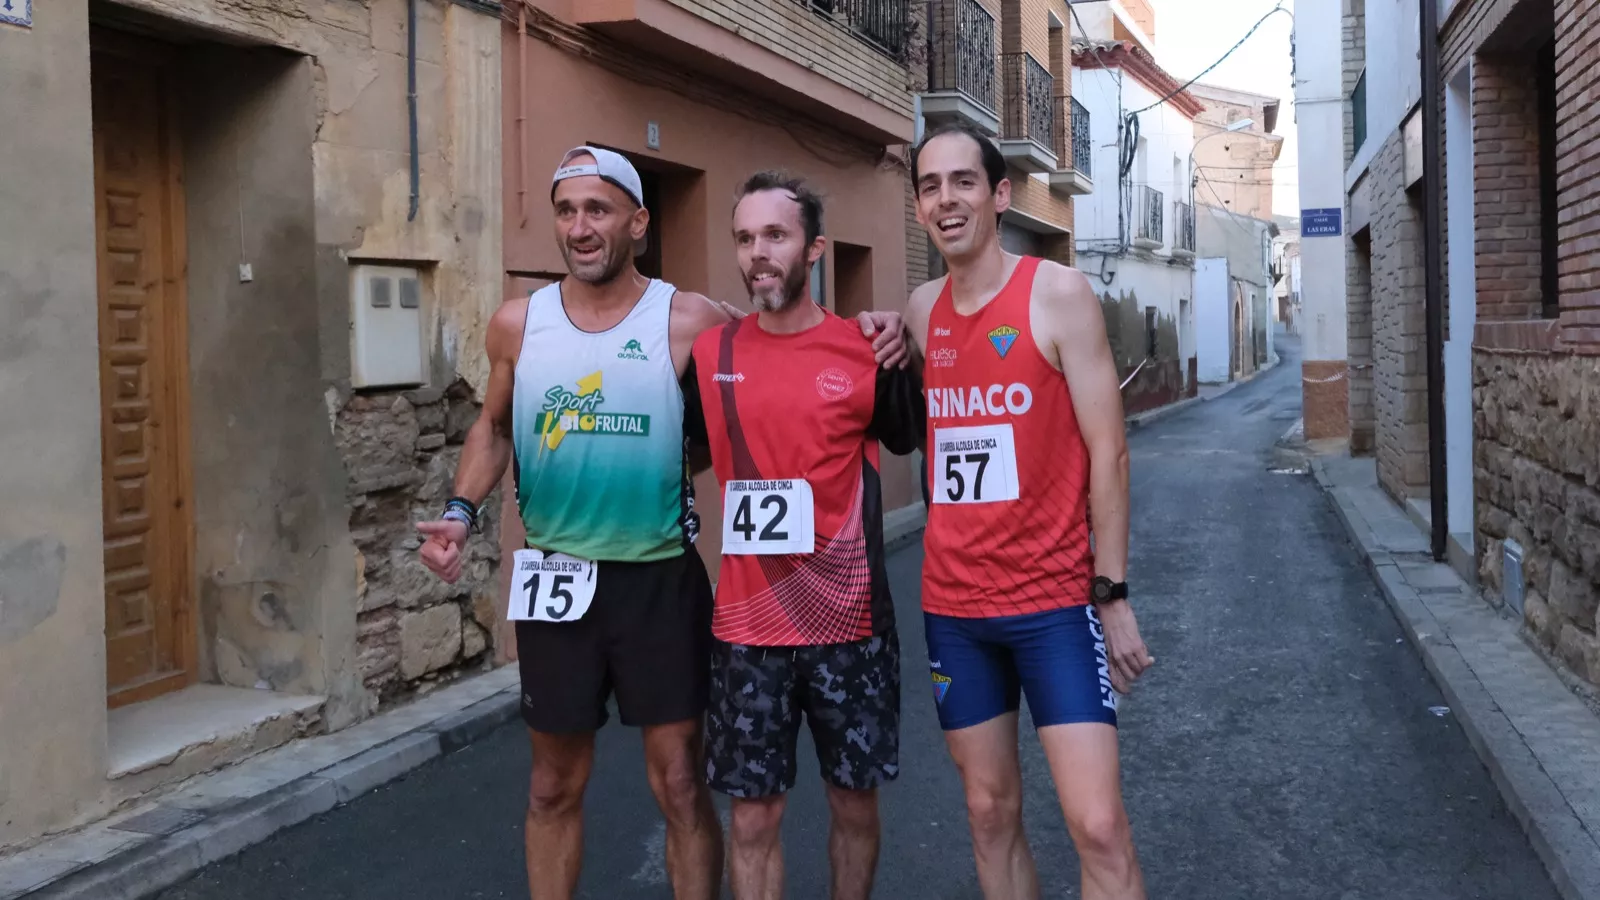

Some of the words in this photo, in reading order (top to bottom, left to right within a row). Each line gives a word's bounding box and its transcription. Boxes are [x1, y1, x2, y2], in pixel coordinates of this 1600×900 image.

[543, 385, 604, 419] Sport
[560, 414, 643, 433] BIOFRUTAL
[955, 440, 974, 451] ALCOLEA
[974, 439, 980, 450] DE
[981, 438, 997, 449] CINCA
[732, 482, 747, 492] CARRERA
[748, 481, 770, 491] ALCOLEA
[770, 481, 777, 490] DE
[777, 480, 793, 490] CINCA
[946, 453, 990, 501] 57
[733, 494, 789, 541] 42
[541, 561, 560, 572] ALCOLEA
[561, 562, 568, 572] DE
[568, 562, 582, 572] CINCA
[523, 573, 574, 620] 15
